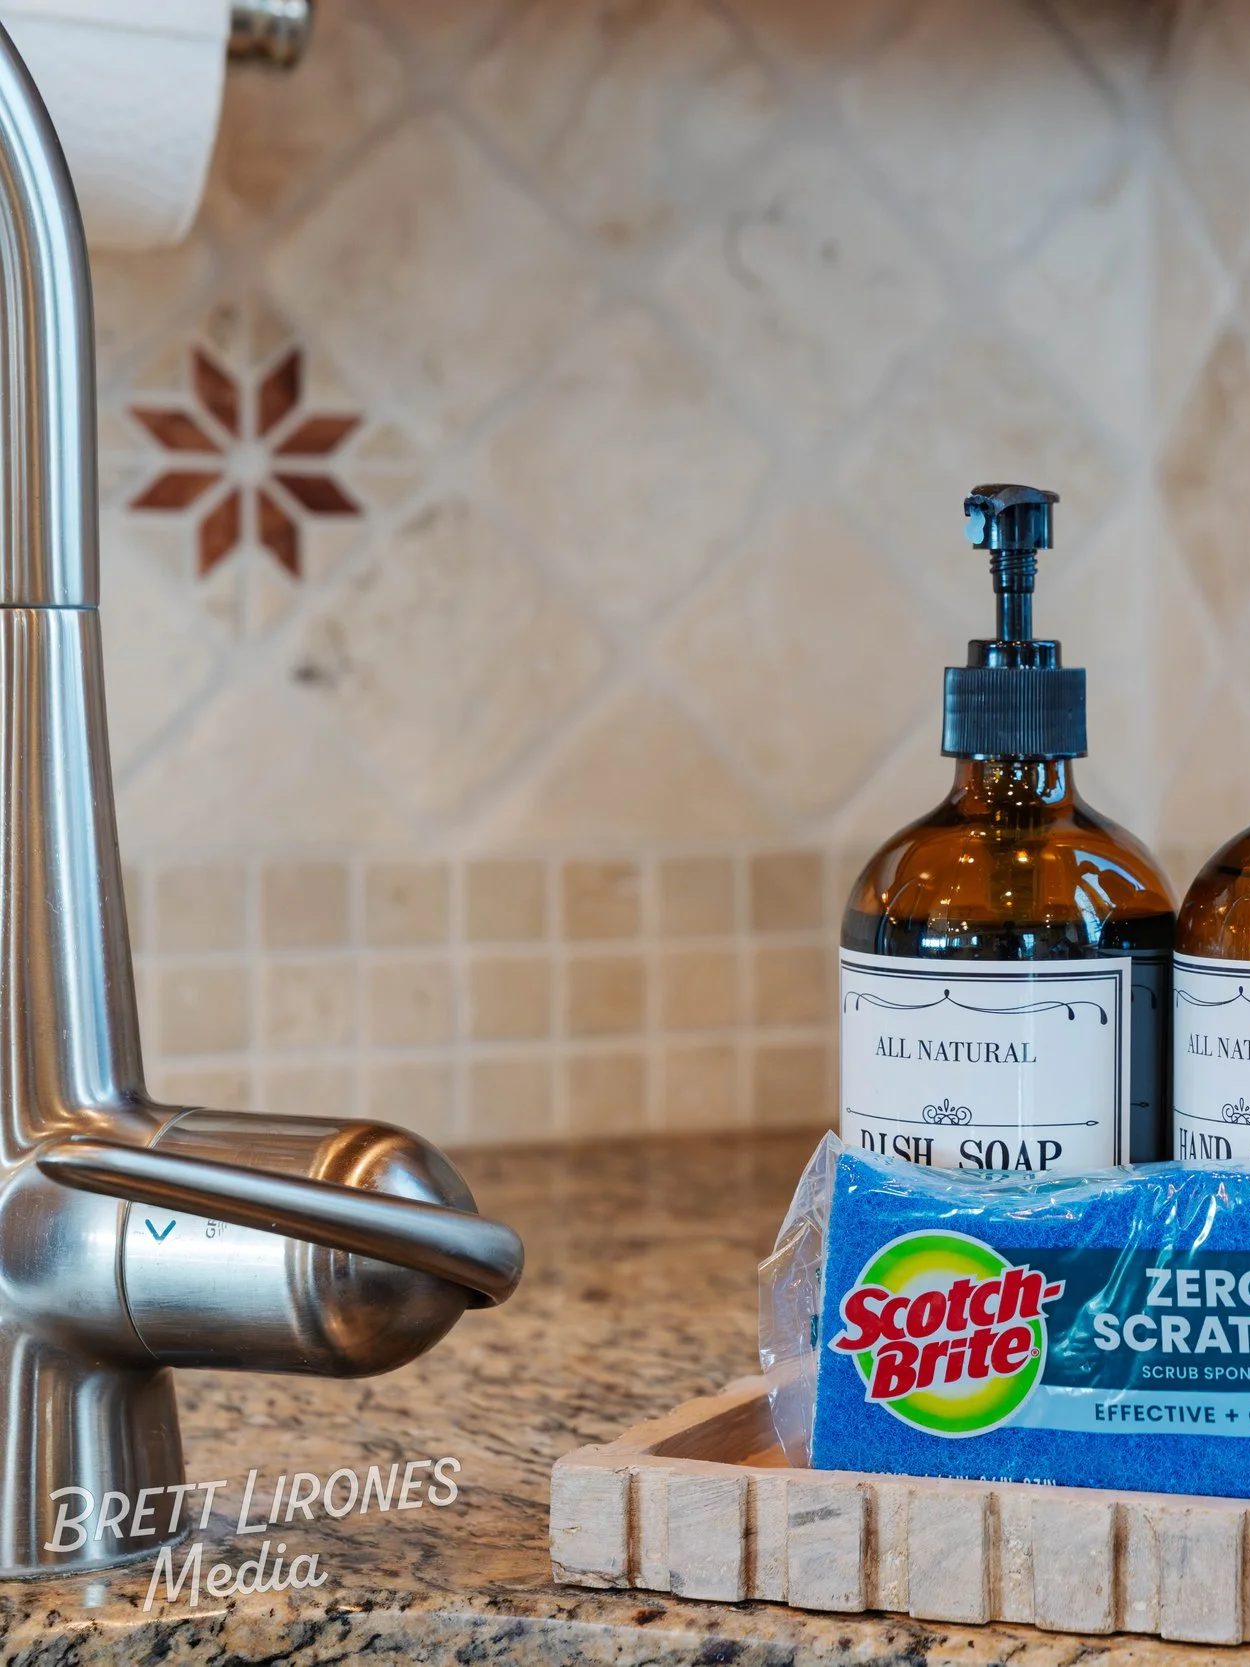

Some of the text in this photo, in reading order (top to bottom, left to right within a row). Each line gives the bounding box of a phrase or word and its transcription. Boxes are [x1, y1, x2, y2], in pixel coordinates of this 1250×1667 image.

[875, 1035, 1037, 1064] ALL NATURAL
[1187, 1033, 1213, 1057] ALL
[861, 1129, 1062, 1171] DISH SOAP
[1179, 1128, 1232, 1161] HAND
[835, 1268, 1062, 1351] Scotch-
[1142, 1365, 1199, 1380] SCRUB
[1095, 1403, 1216, 1424] EFFECTIVE
